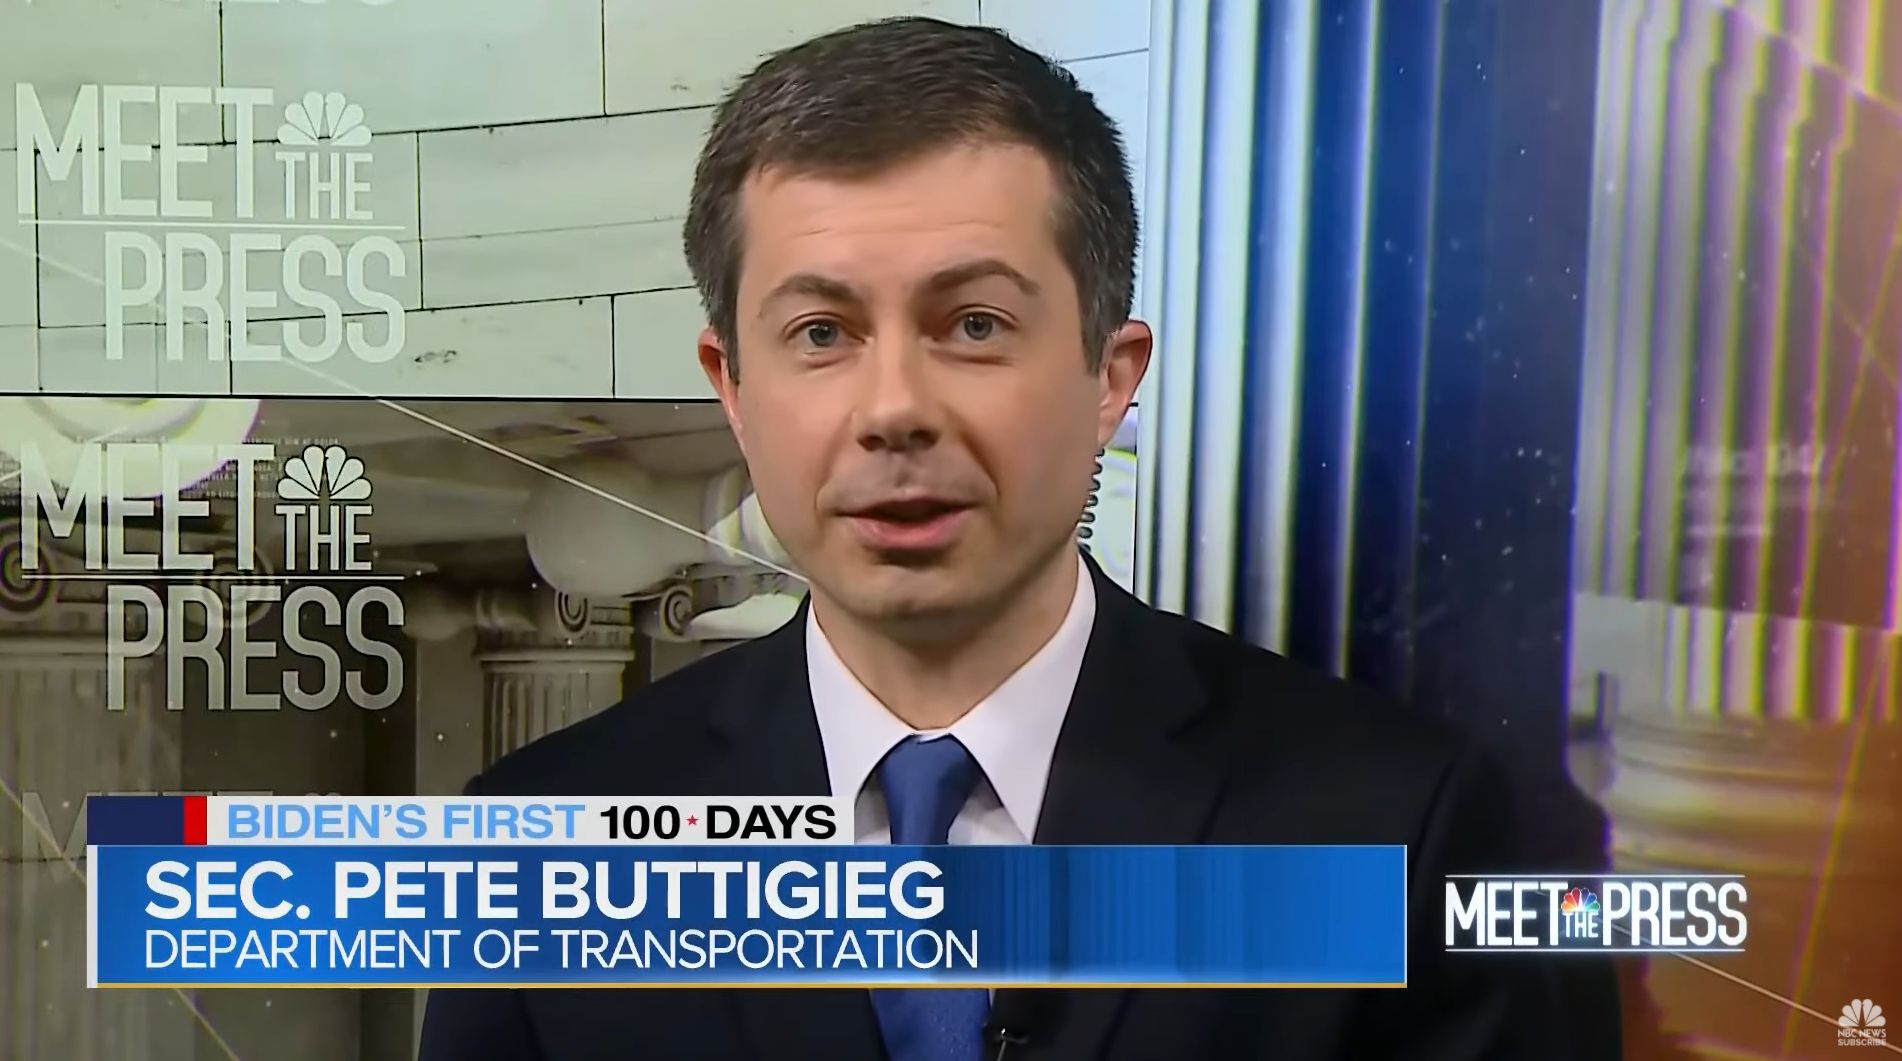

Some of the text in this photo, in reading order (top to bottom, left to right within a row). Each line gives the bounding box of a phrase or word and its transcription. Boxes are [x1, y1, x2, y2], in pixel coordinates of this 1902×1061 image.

[15, 82, 374, 220] MEET THE
[104, 231, 407, 363] PRESS
[20, 441, 373, 571] MEET THE
[106, 585, 405, 711] PRESS
